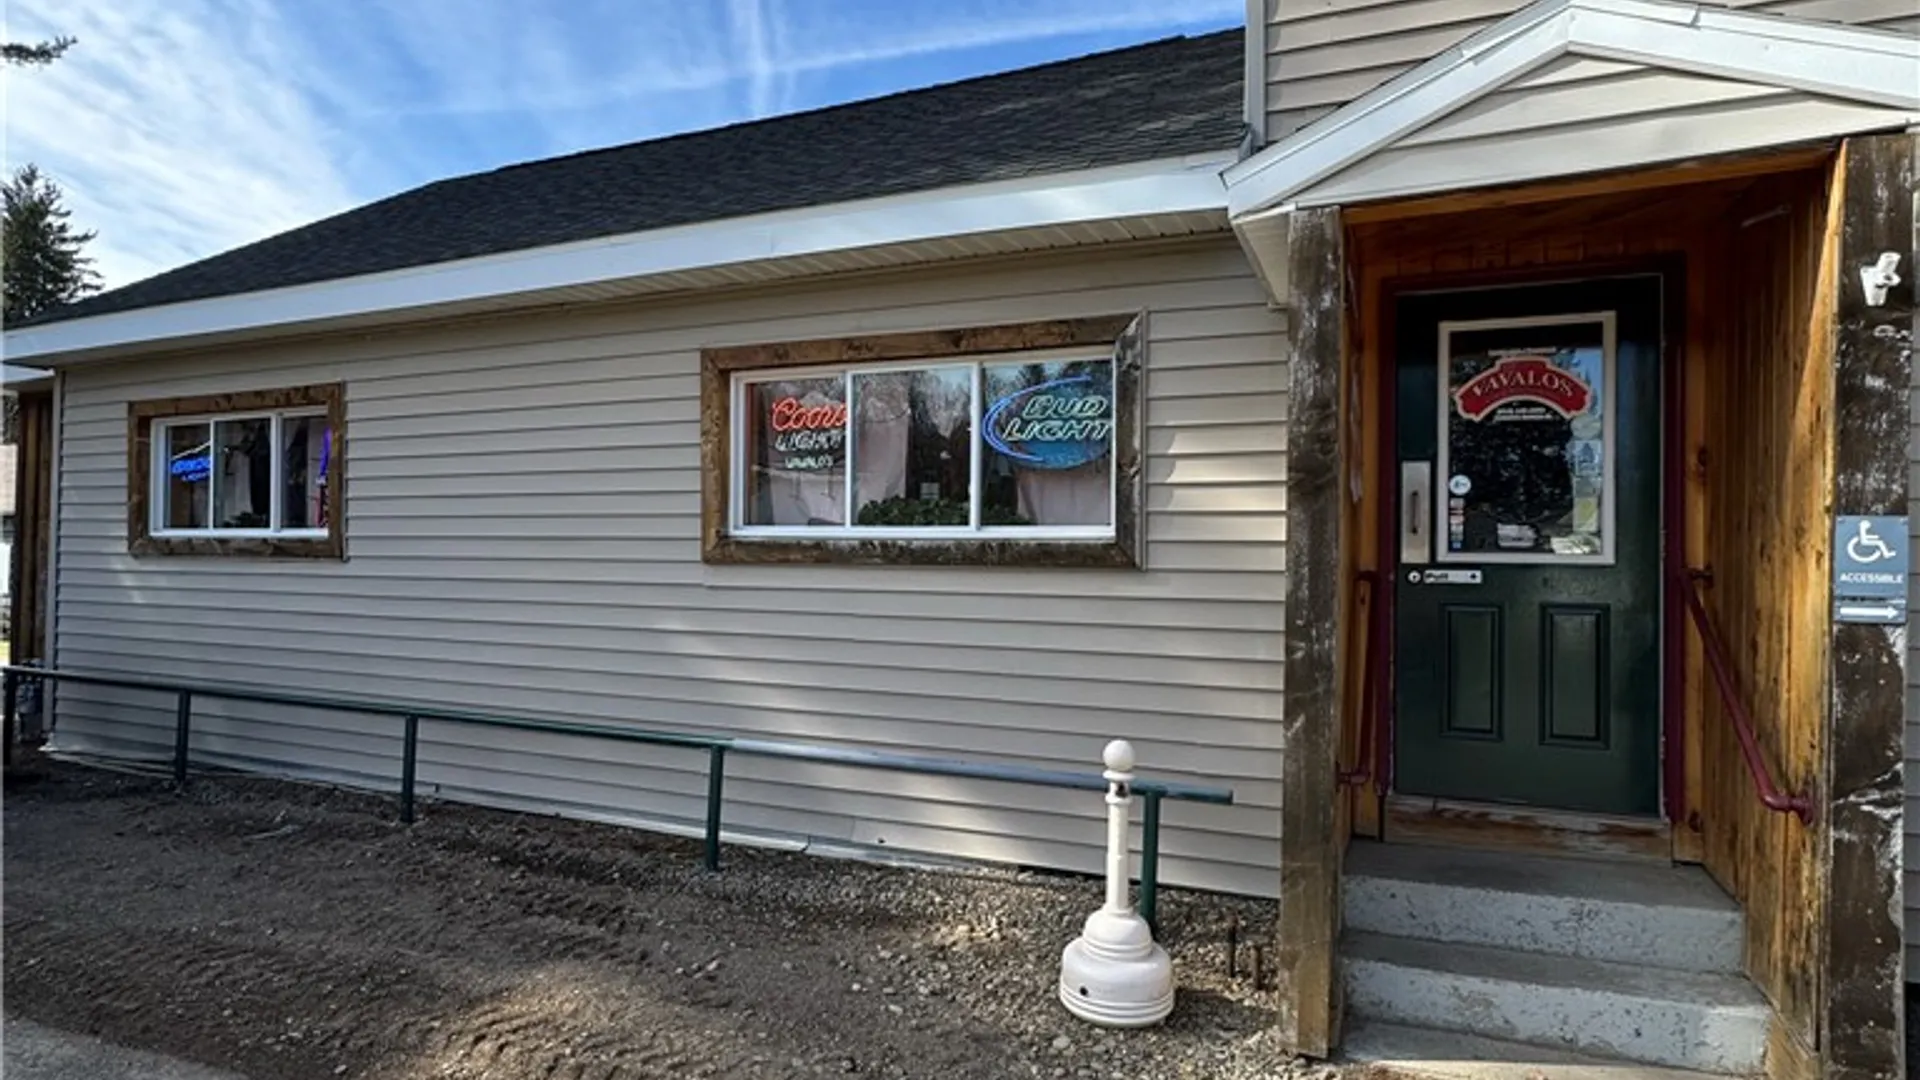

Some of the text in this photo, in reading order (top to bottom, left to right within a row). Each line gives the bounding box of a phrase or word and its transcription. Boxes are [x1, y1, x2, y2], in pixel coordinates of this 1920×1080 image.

[772, 397, 846, 431] Coors
[1022, 395, 1108, 419] BUD
[775, 430, 842, 451] LIGHT
[1001, 417, 1113, 441] LIGHT
[1839, 572, 1904, 584] ACCESSIBLE
